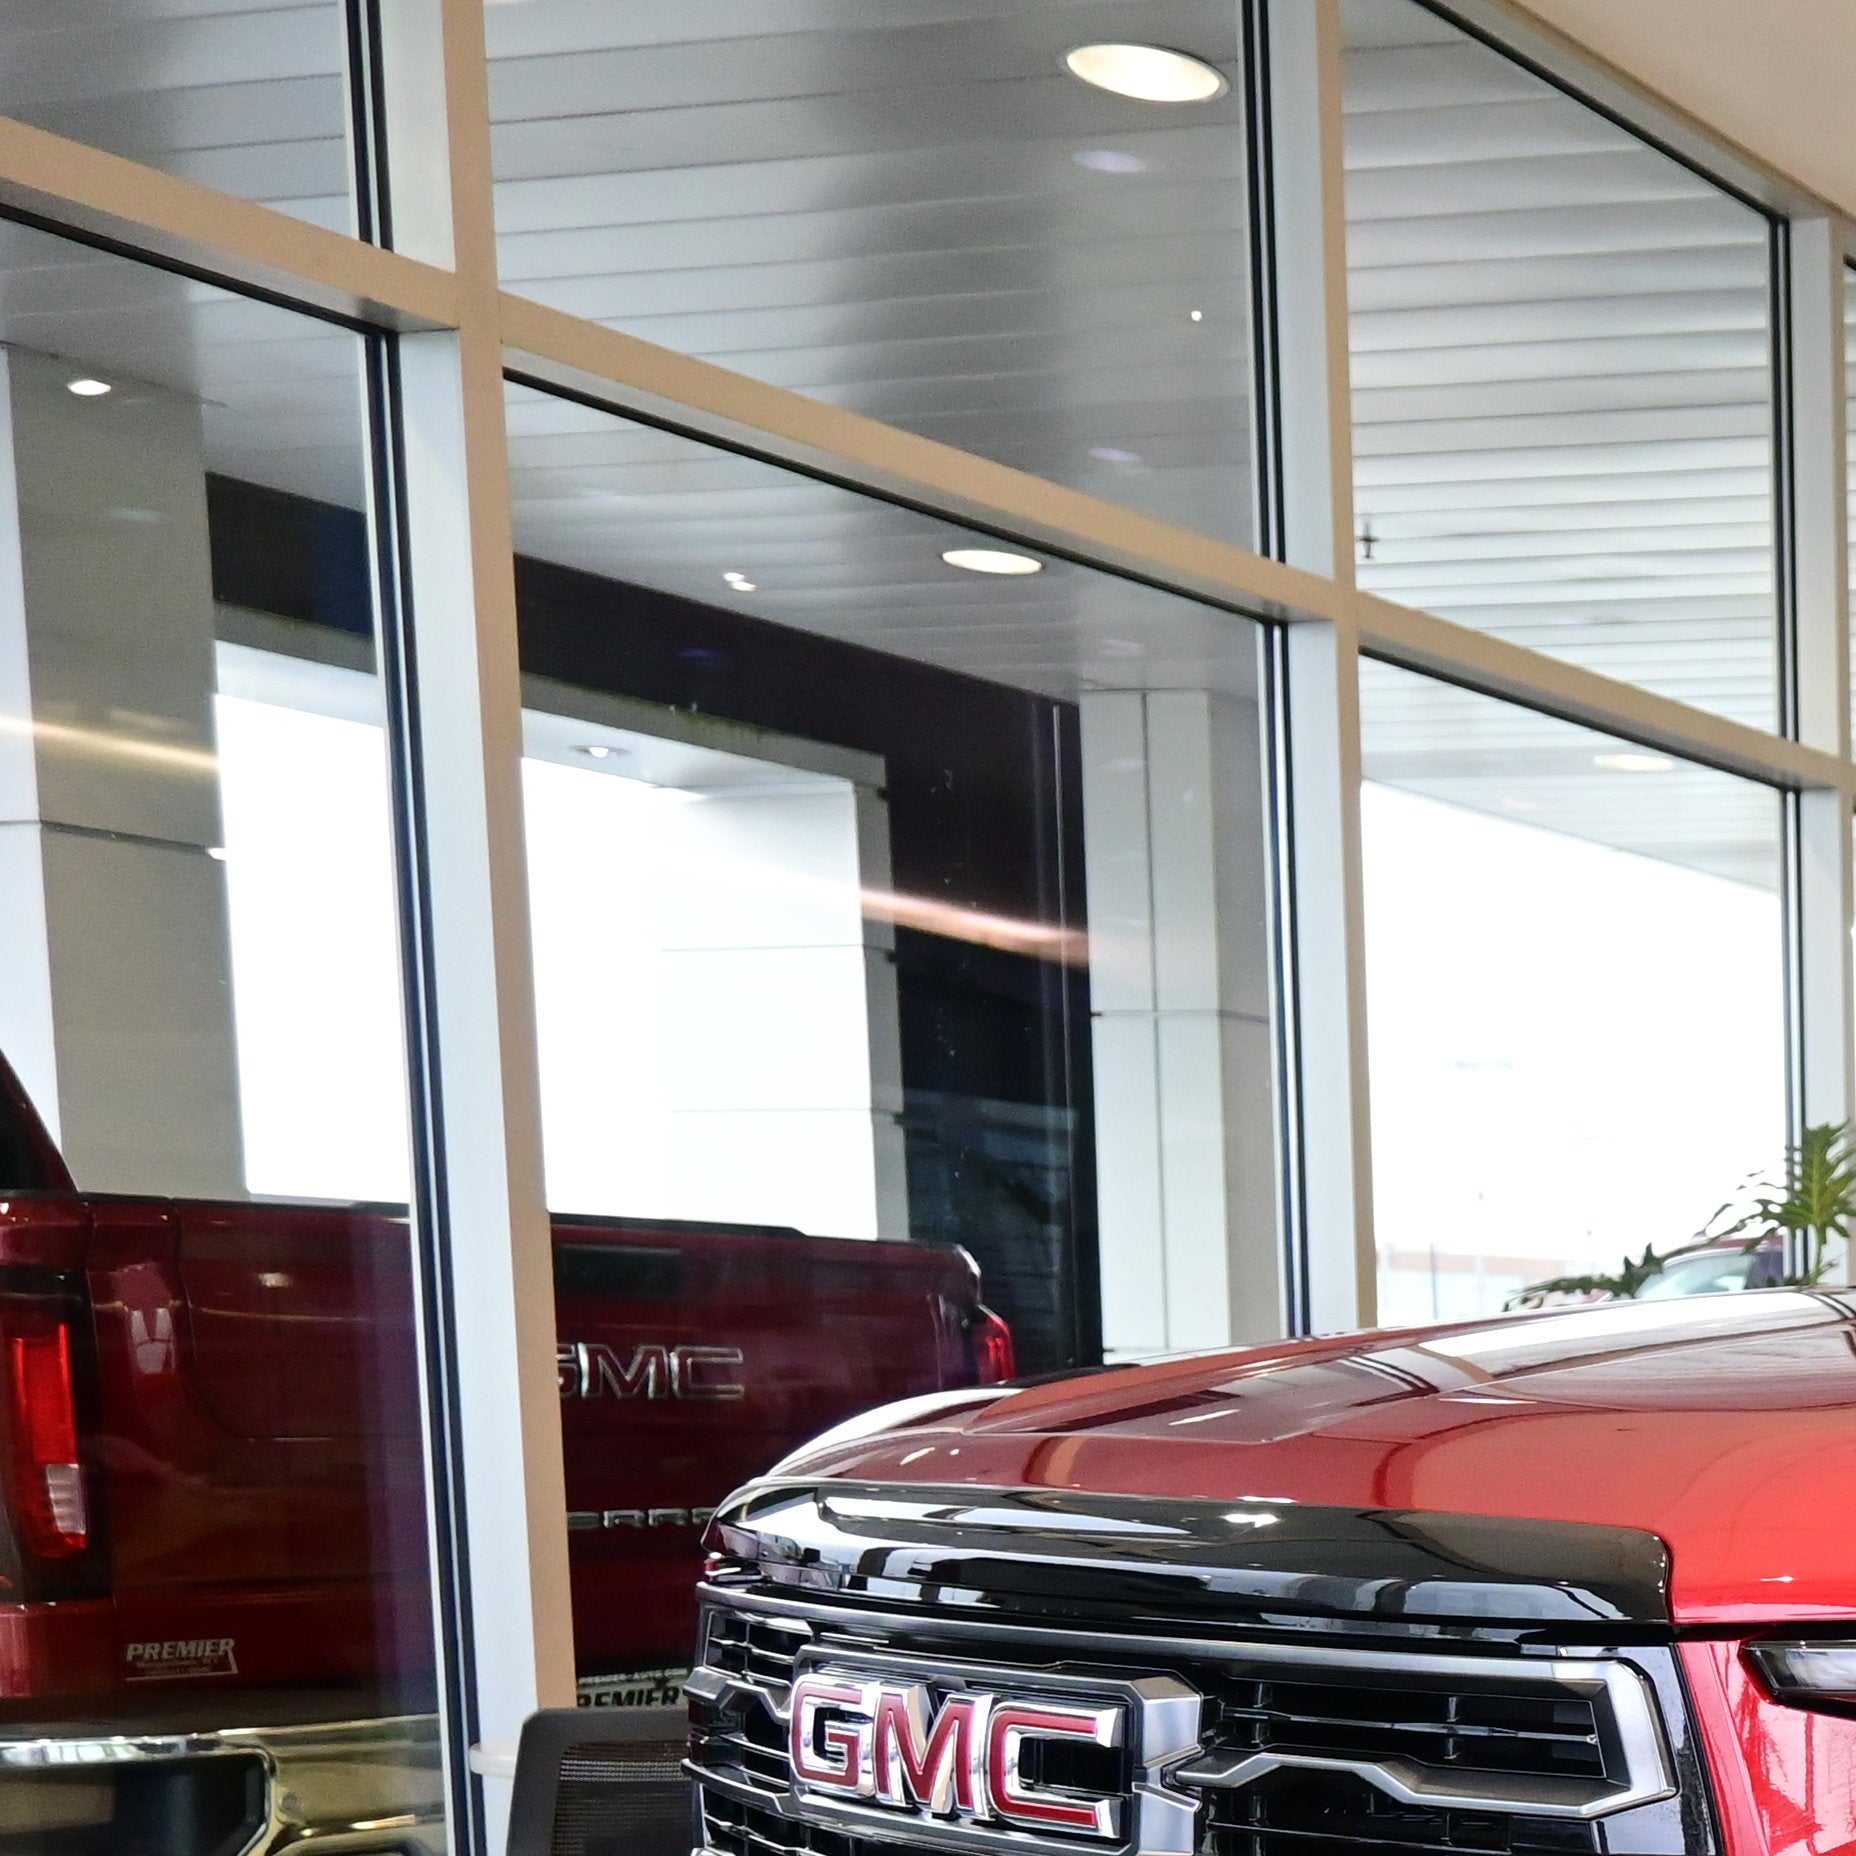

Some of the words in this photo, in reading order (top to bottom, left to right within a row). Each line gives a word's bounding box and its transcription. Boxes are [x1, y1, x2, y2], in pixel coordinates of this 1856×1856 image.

[126, 1638, 236, 1662] PREMIER
[576, 1685, 680, 1707] REMIER
[789, 1674, 1123, 1839] GMC
